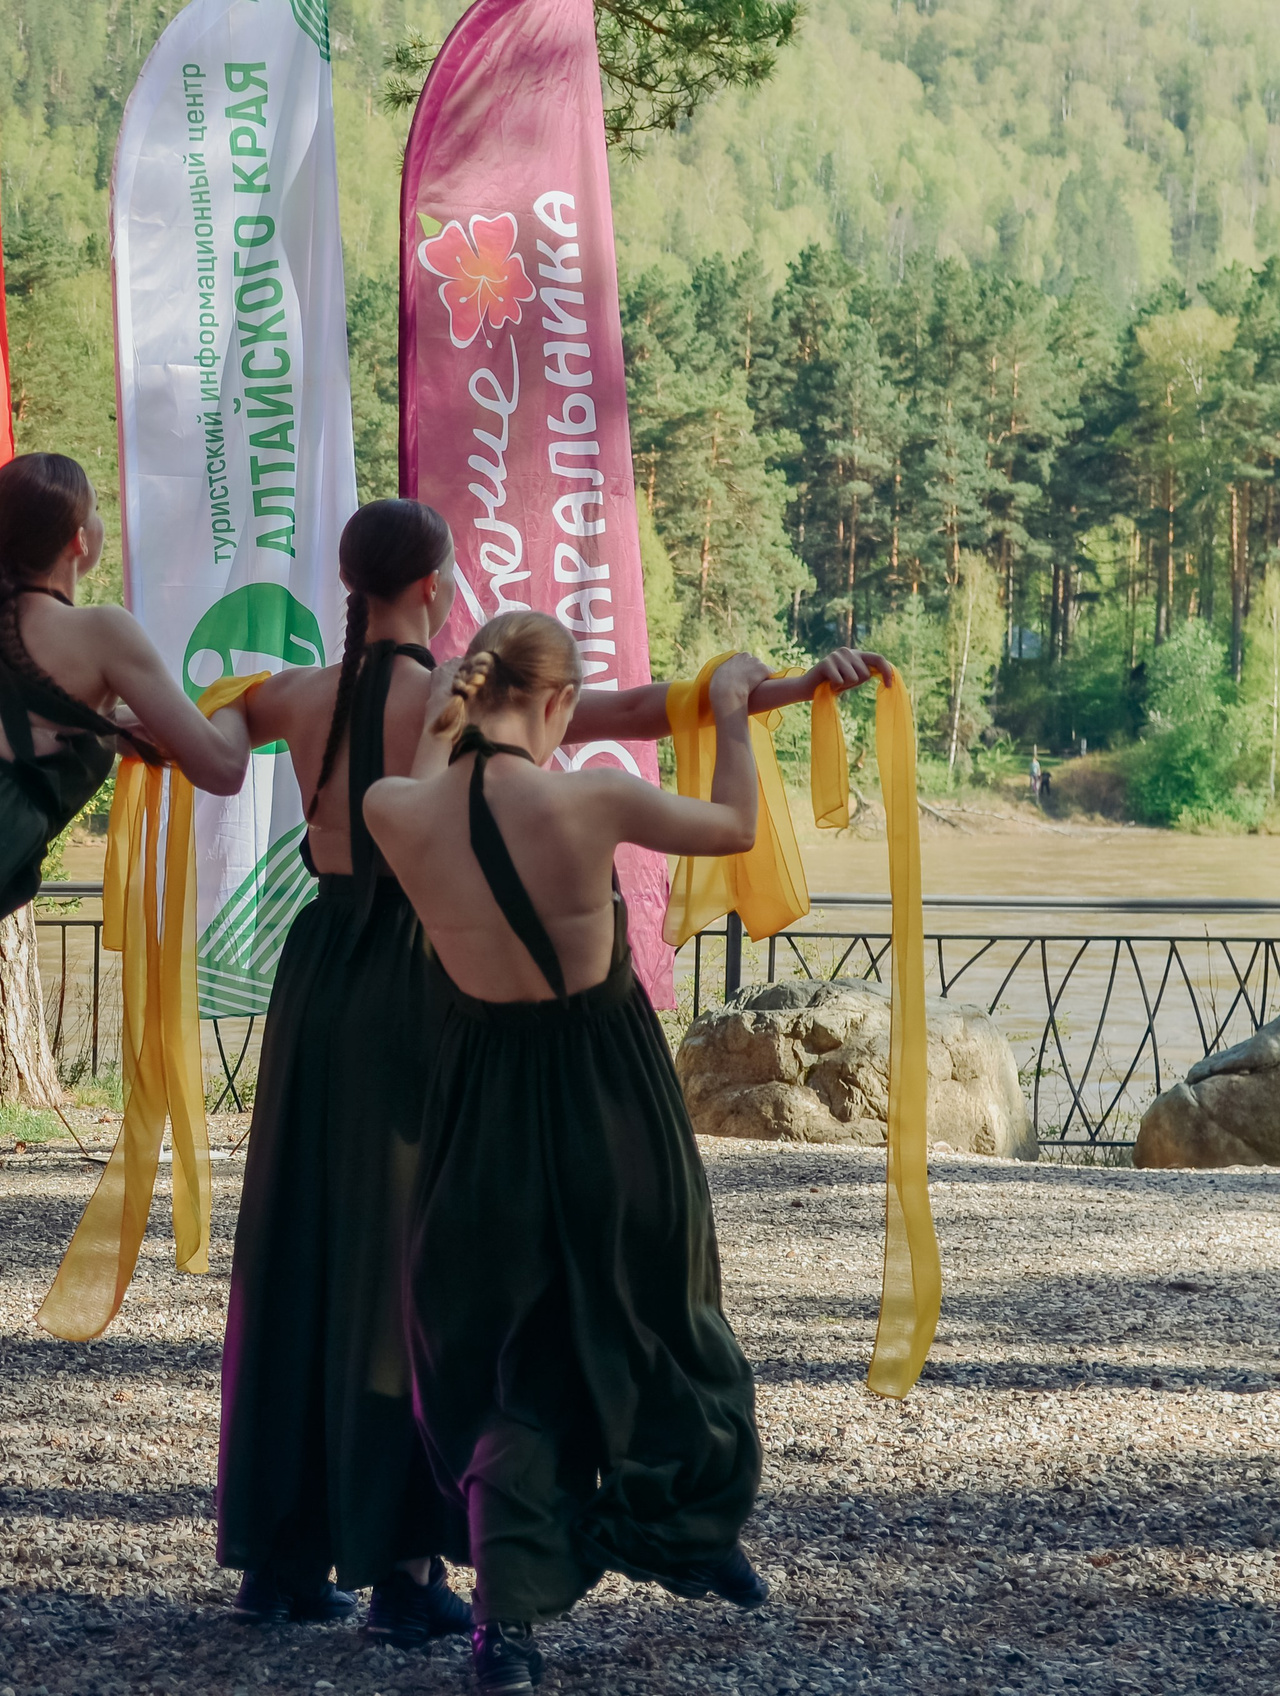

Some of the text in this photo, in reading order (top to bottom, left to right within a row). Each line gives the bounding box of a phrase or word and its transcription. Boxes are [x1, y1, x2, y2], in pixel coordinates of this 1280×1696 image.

[181, 63, 238, 565] туристский информационный центр
[223, 61, 296, 559] АЛТАЙСКОГО КРАЯ
